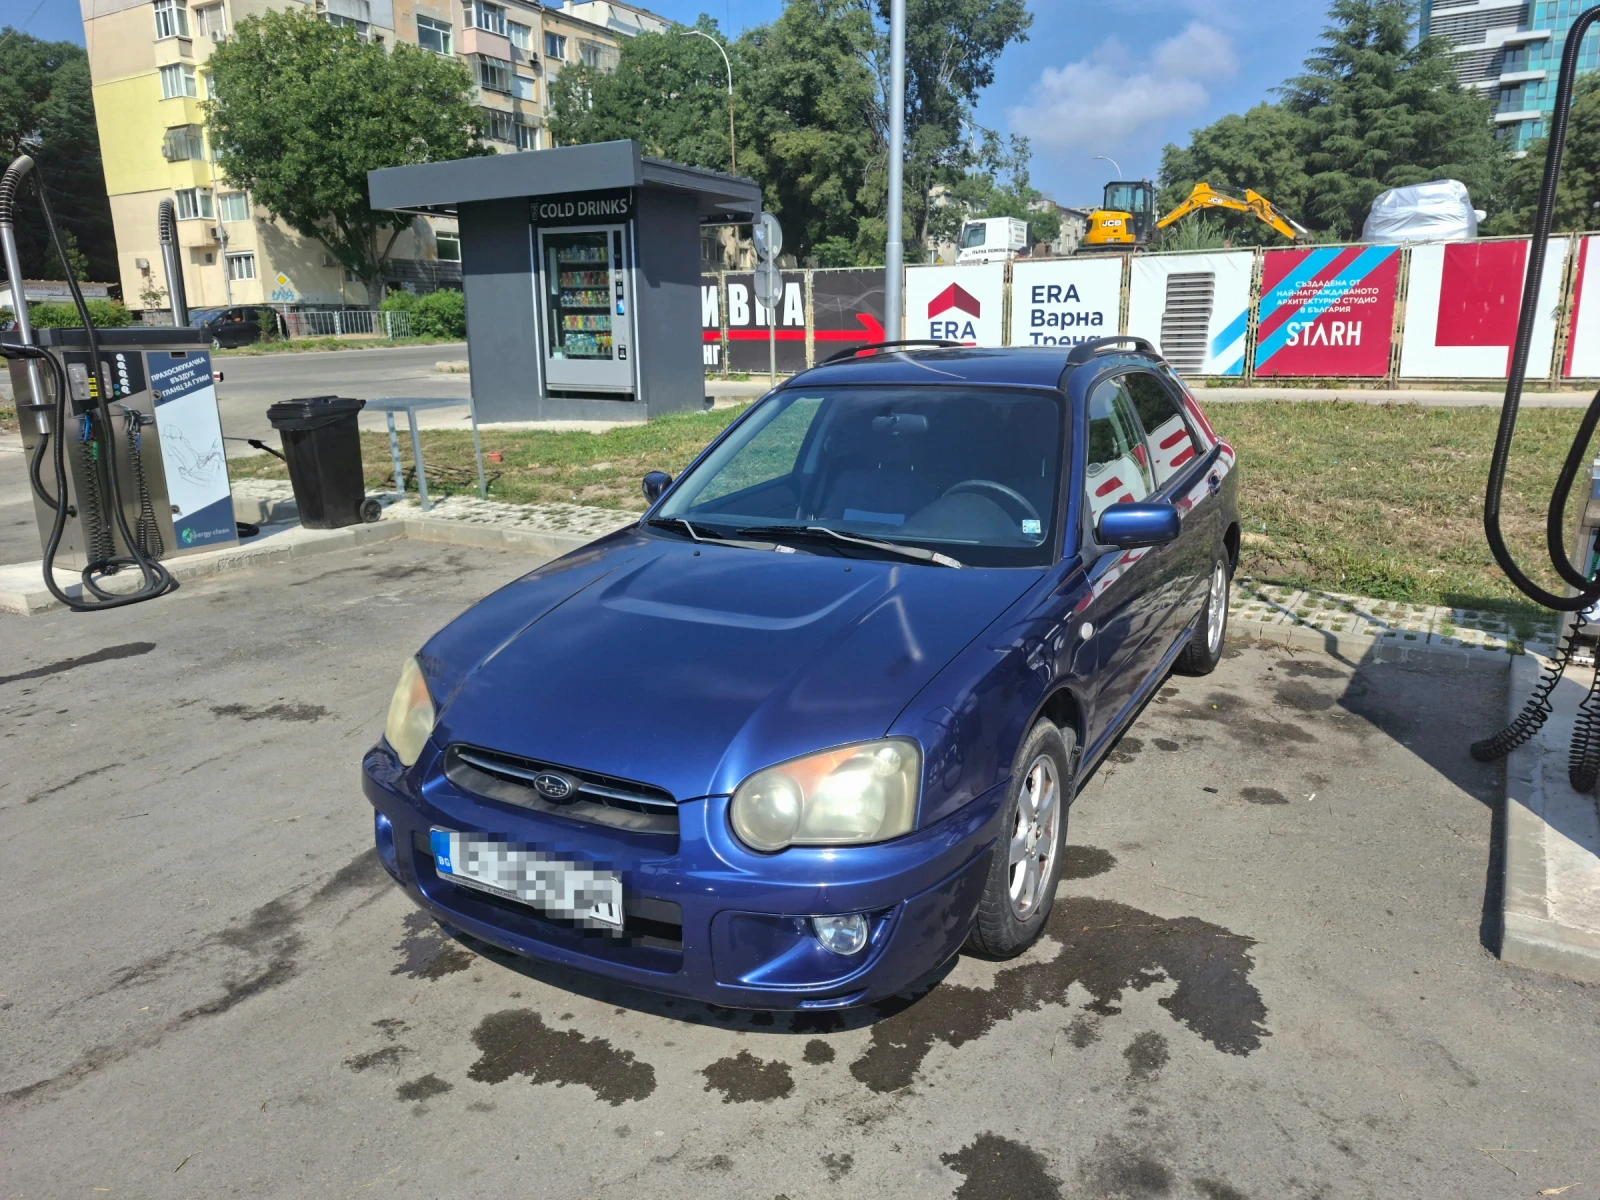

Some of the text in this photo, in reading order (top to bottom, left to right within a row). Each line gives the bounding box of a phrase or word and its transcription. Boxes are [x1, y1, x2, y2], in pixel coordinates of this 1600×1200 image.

[540, 202, 574, 218] COLD
[578, 198, 628, 216] DRINKS
[1101, 219, 1122, 227] JCB
[1031, 284, 1081, 304] ERA
[1276, 288, 1379, 296] НАЙ-НАГРАЖДАВАНОТО
[1031, 308, 1104, 330] Варна
[1300, 306, 1306, 314] В
[930, 321, 977, 340] ERA
[1286, 321, 1362, 346] STARH
[151, 357, 206, 381] ПРАХОСМУКАЧКА
[170, 370, 195, 384] ВЪЗДУХ
[162, 374, 210, 397] ГЛАНЦ ЗА ГУМИ
[189, 531, 211, 539] Energy
[438, 855, 451, 867] BG
